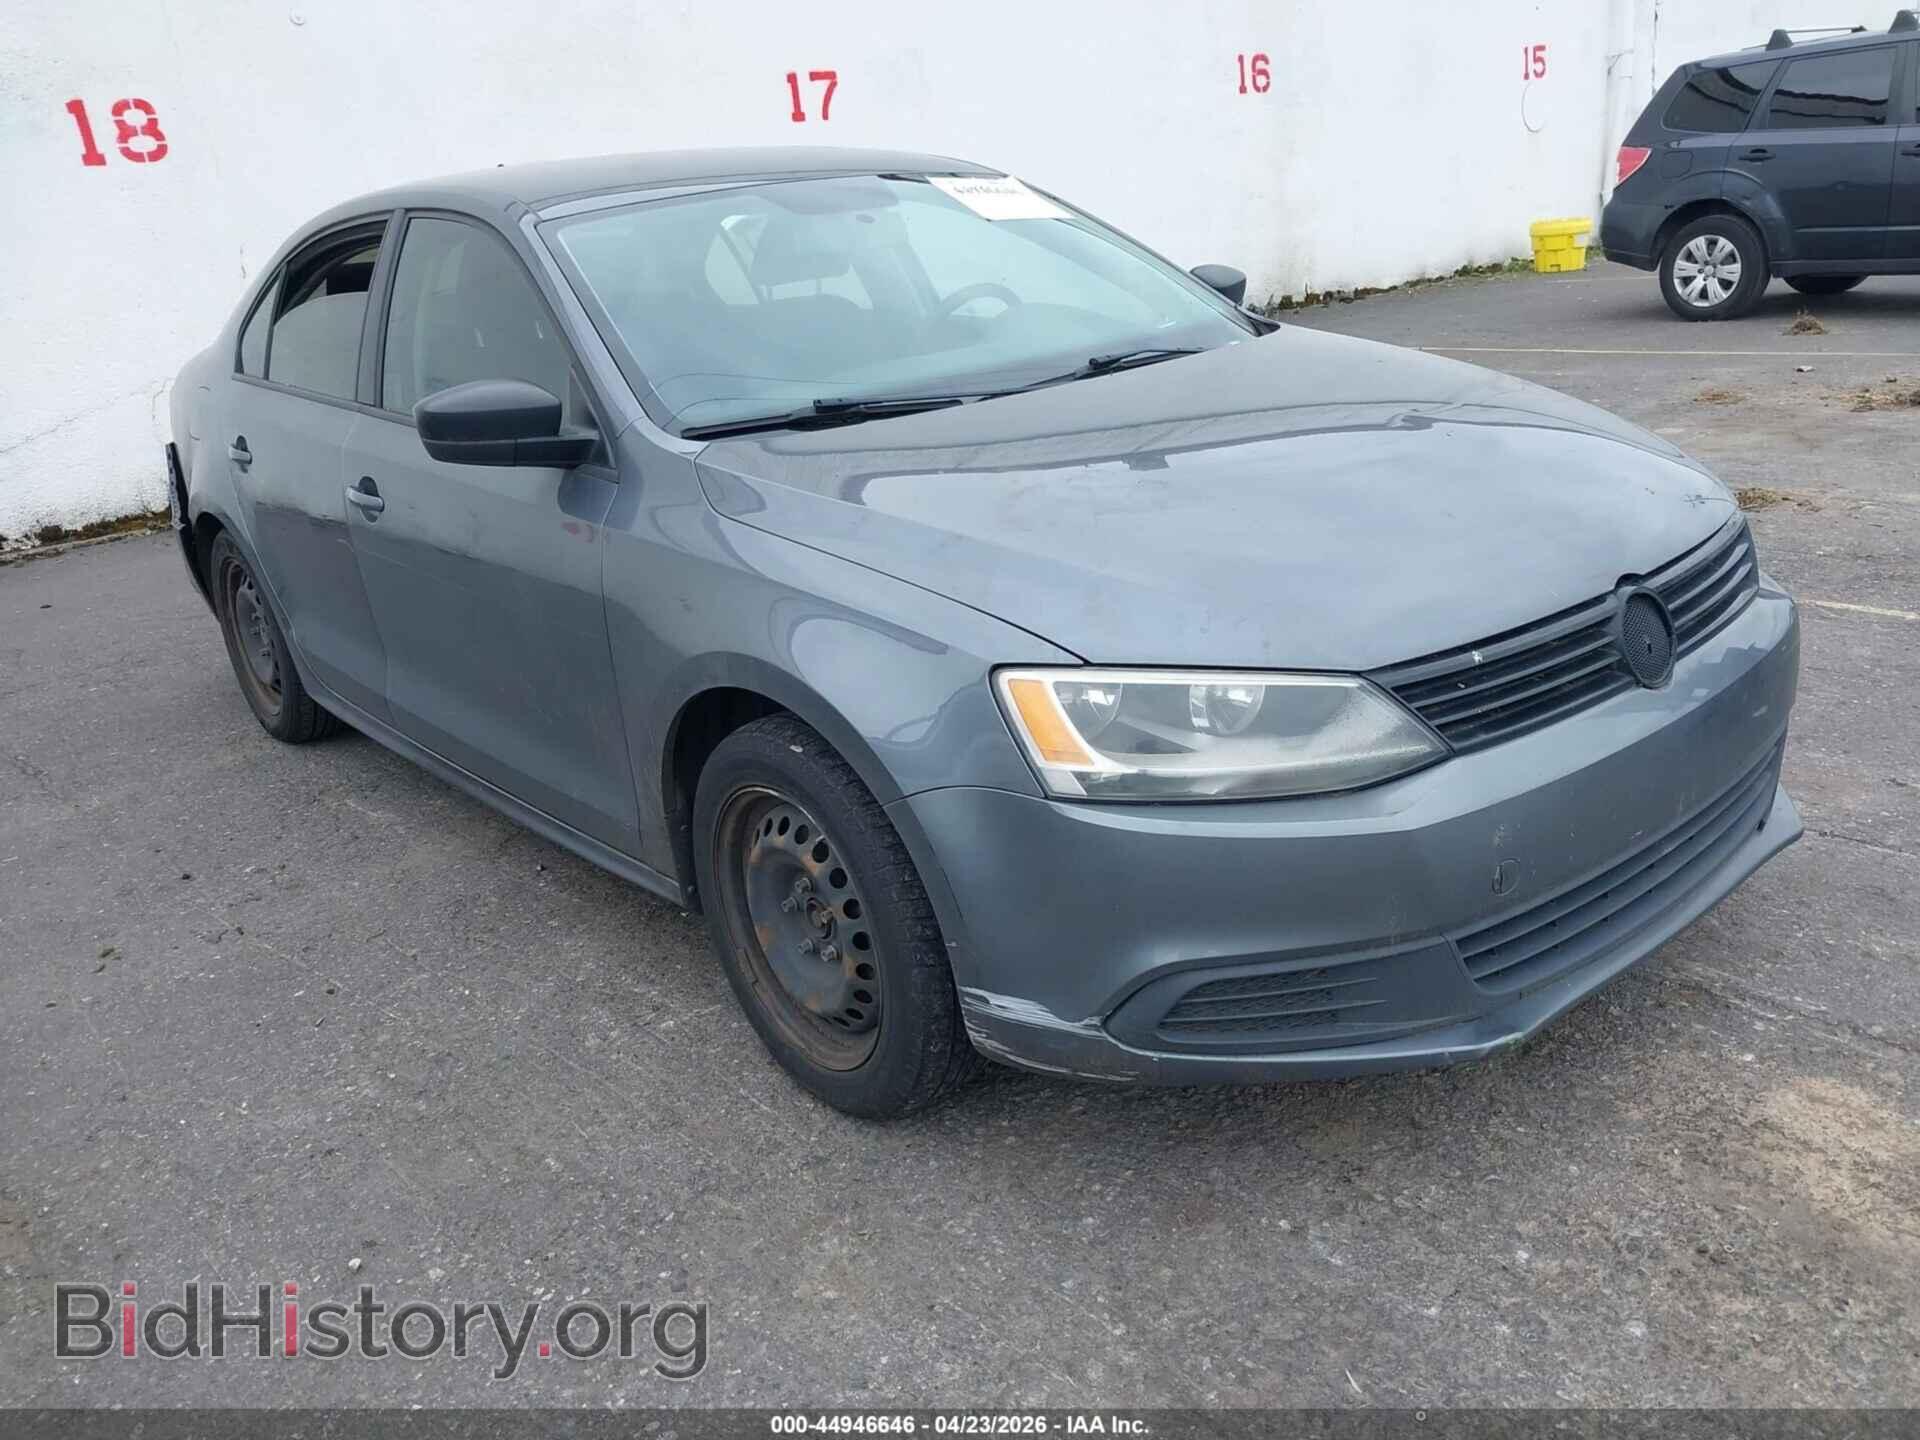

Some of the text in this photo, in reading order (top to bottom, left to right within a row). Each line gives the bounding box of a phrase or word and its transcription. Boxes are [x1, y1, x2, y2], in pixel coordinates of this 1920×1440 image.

[1237, 53, 1271, 94] 16
[1523, 44, 1547, 80] 15
[786, 70, 838, 122] 17
[65, 98, 169, 166] 18
